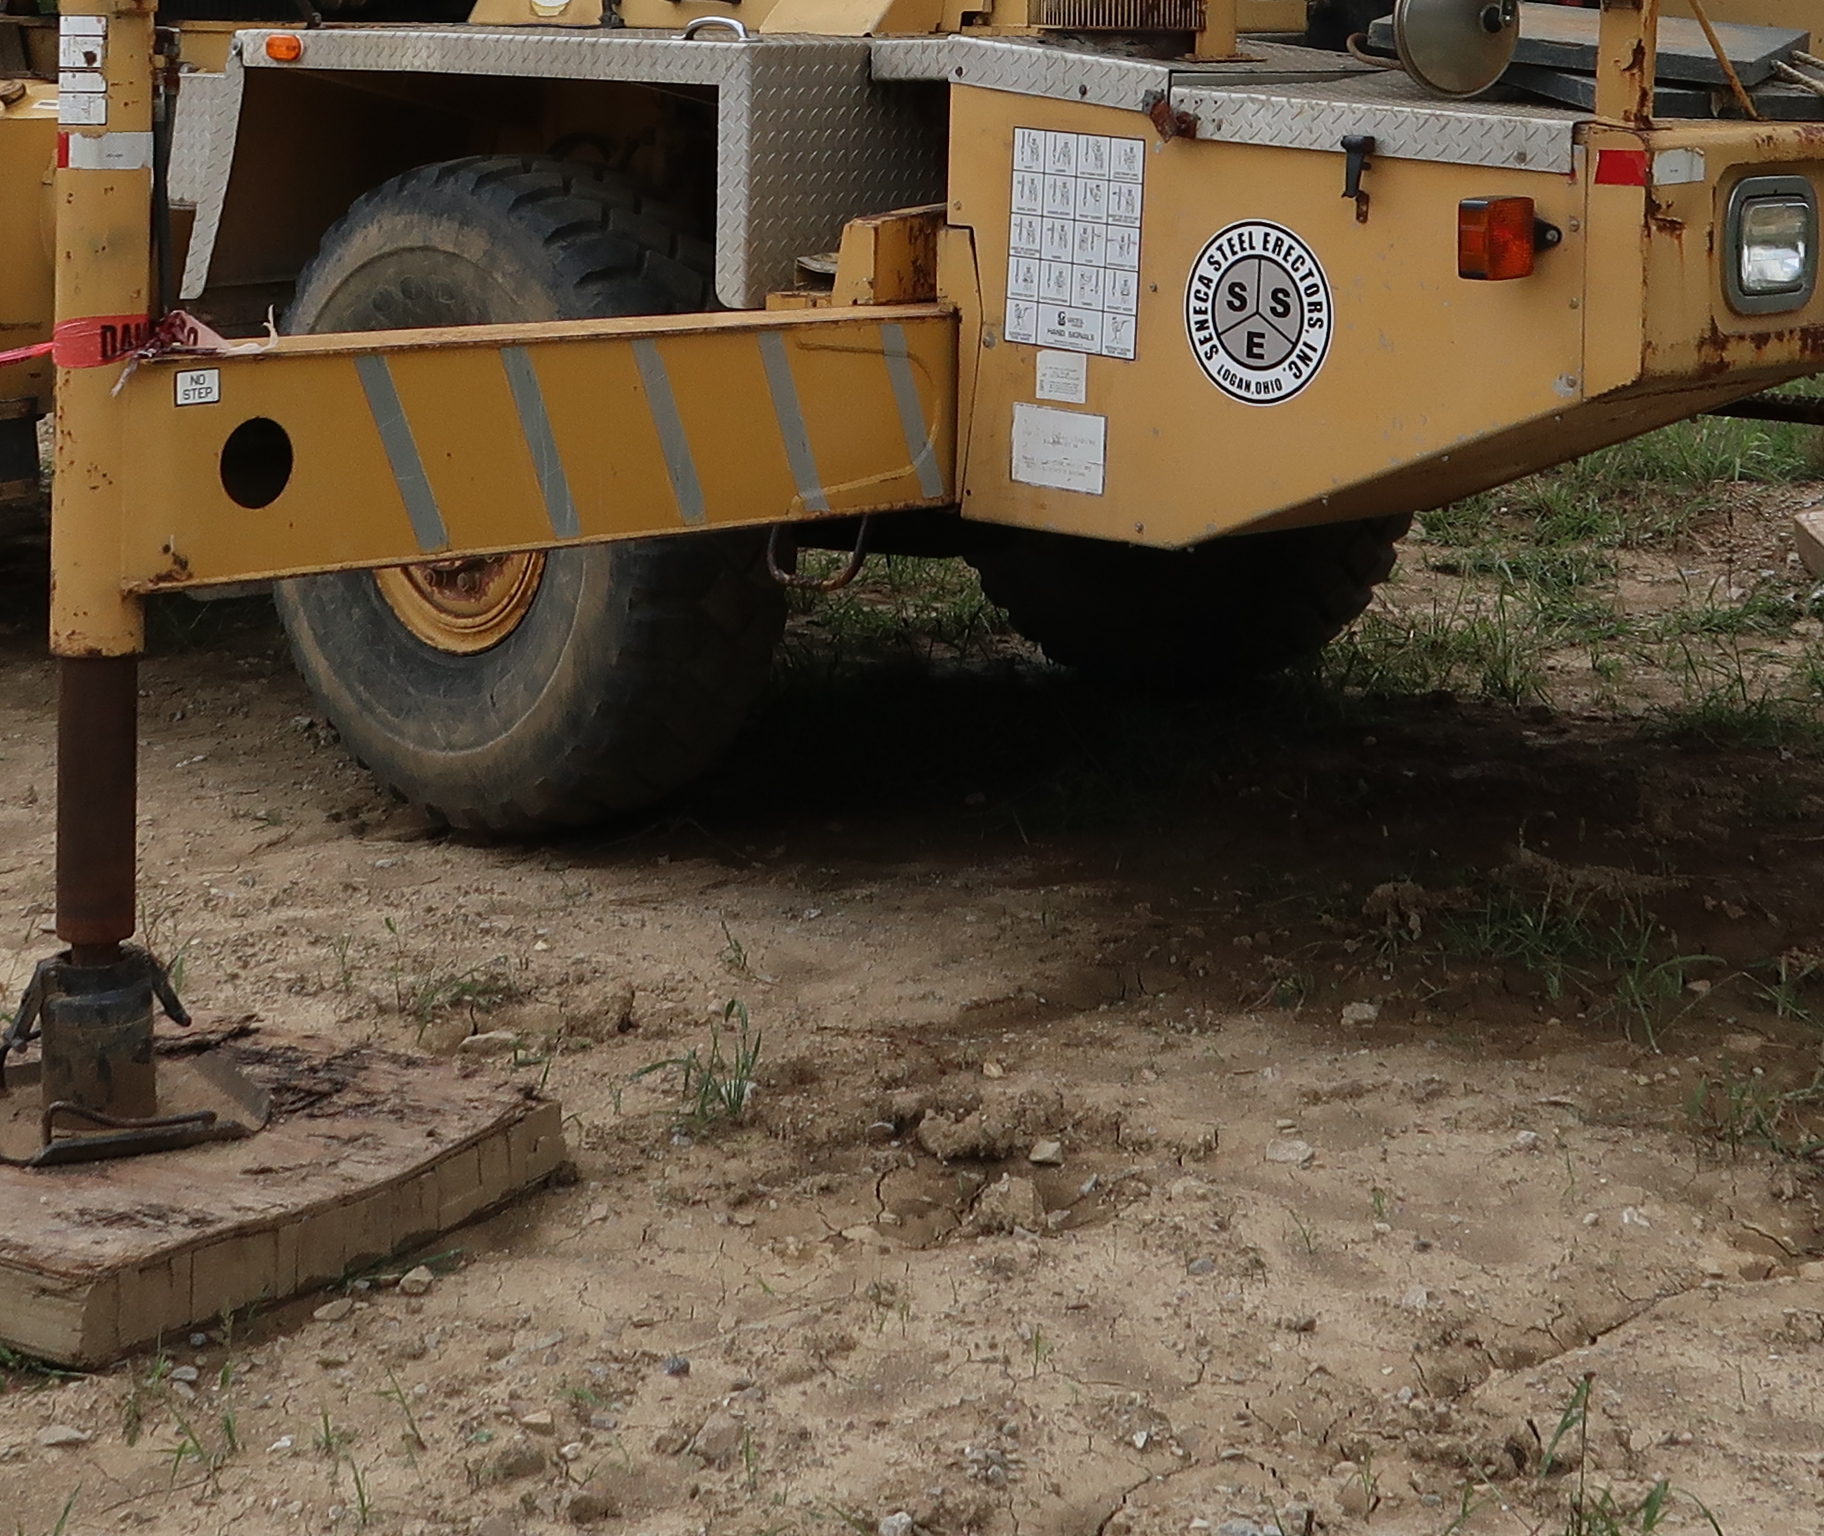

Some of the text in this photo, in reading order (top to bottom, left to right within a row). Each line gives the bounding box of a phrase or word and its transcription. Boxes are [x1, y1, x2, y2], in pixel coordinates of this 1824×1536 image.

[1192, 230, 1324, 380] SENECA STEEL ERECTORS, INC.
[1226, 281, 1292, 319] S S
[1245, 330, 1267, 360] E
[182, 386, 214, 401] STEP
[189, 373, 206, 386] NO
